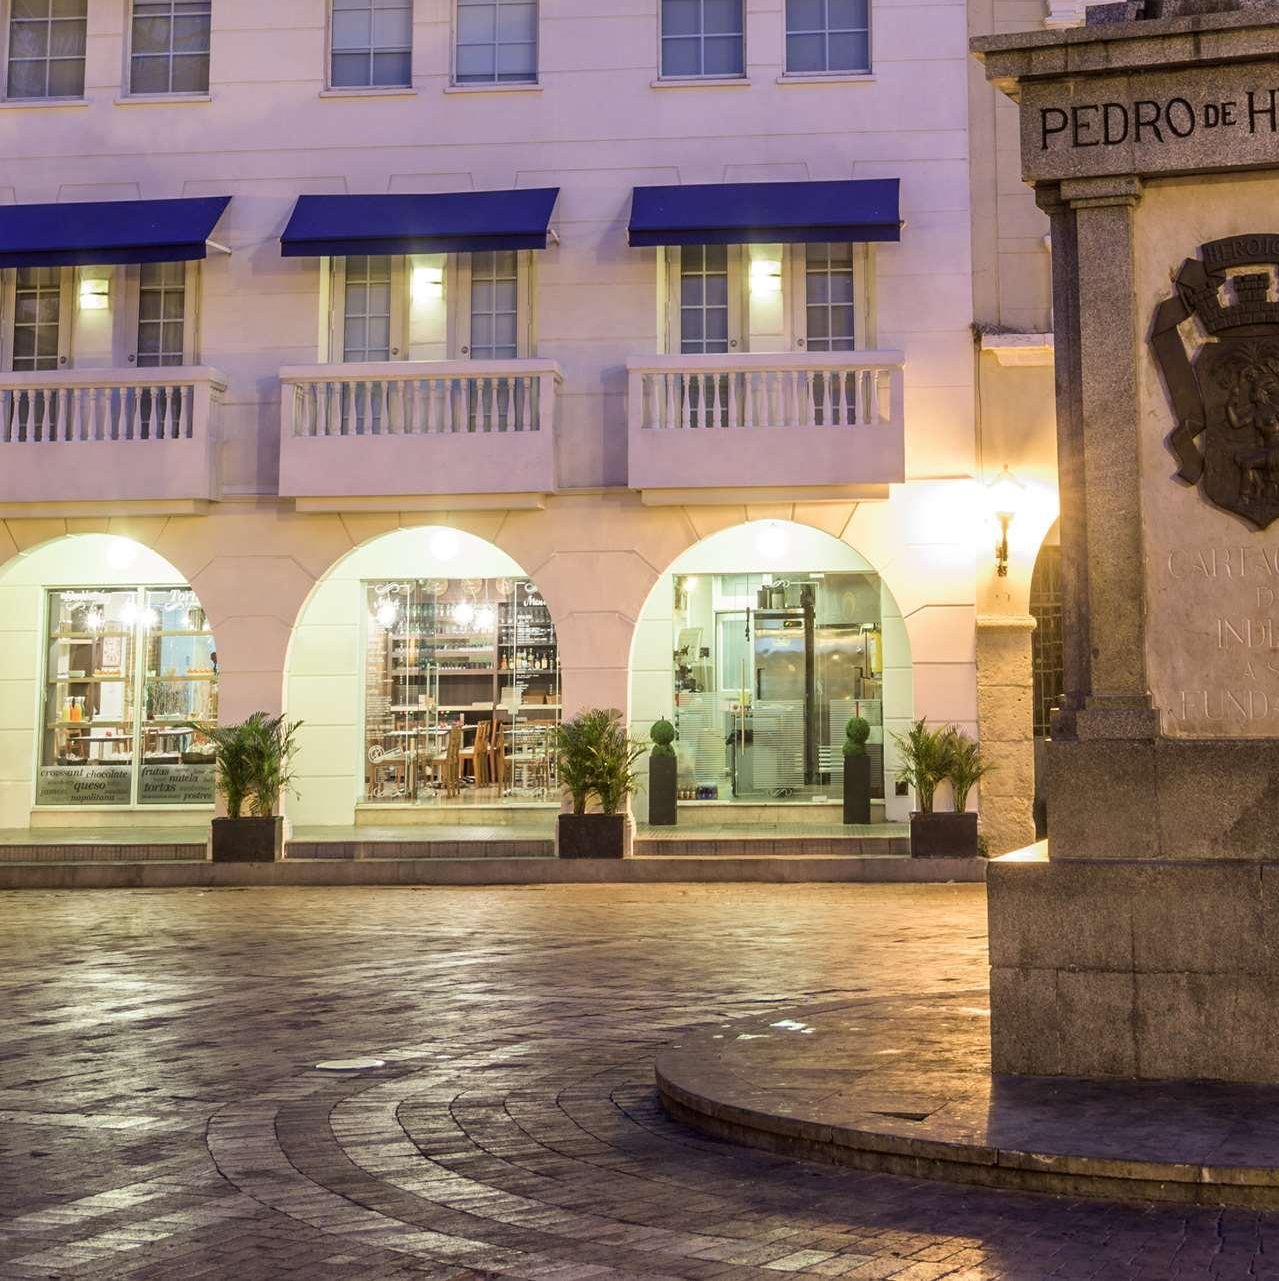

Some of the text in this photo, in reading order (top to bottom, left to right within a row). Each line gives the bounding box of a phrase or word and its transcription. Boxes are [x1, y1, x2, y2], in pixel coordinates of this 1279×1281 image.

[1040, 97, 1196, 150] PEDRO
[1203, 100, 1237, 128] DE
[85, 769, 128, 779] chocolate
[141, 766, 169, 778] frutas
[73, 781, 106, 793] queso
[143, 782, 177, 792] tortas
